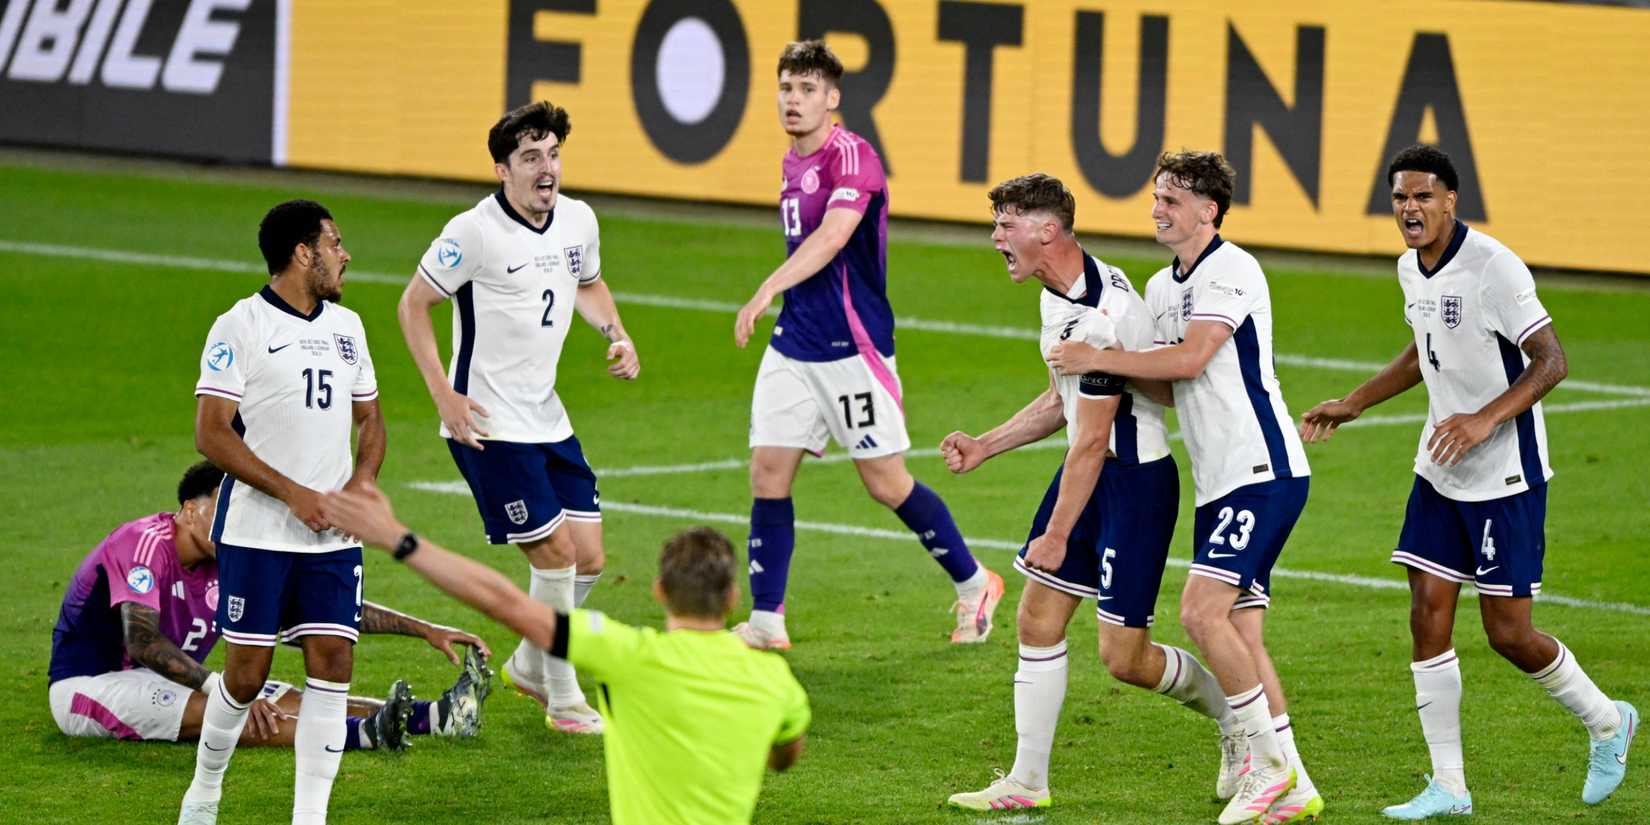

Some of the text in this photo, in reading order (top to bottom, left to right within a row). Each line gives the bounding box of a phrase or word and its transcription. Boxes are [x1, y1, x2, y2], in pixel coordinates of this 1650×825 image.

[0, 0, 252, 94] BILE
[503, 0, 1487, 222] FORTUNA
[781, 198, 802, 236] 13
[541, 288, 555, 328] 2
[1426, 332, 1440, 373] 4
[302, 367, 333, 409] 15
[838, 391, 876, 429] 13
[1208, 506, 1256, 550] 23
[1480, 518, 1496, 561] 4
[1101, 547, 1116, 590] 5
[181, 617, 217, 651] 2
